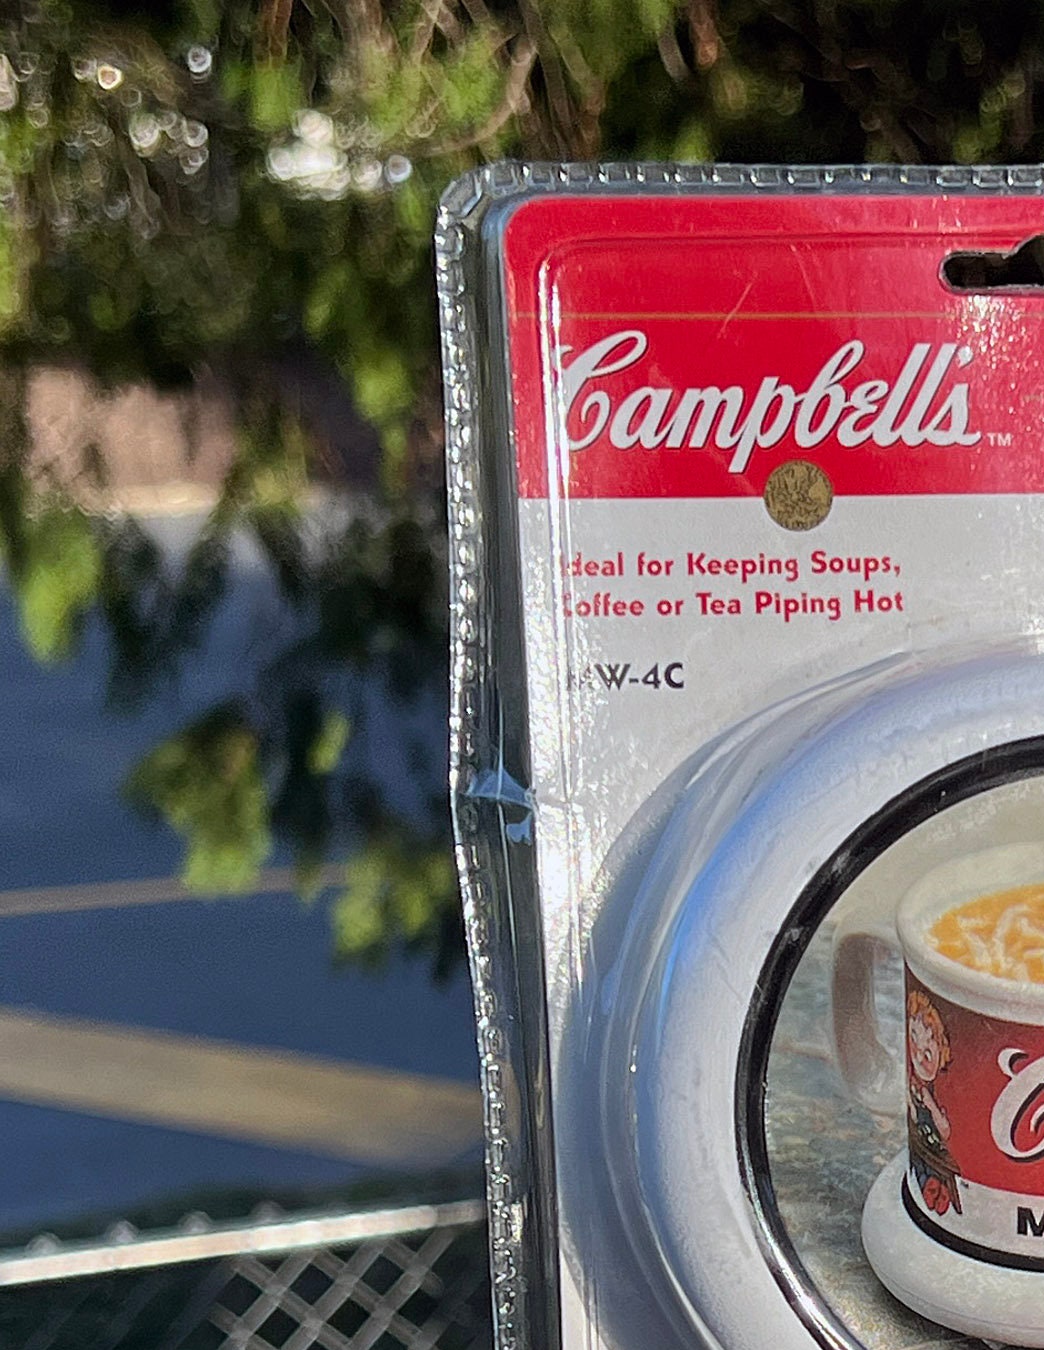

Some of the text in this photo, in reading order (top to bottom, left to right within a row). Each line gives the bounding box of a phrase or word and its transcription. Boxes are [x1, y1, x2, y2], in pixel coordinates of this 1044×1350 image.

[554, 329, 982, 474] Campbell's
[637, 551, 675, 577] for
[687, 551, 799, 582] Keeping
[811, 549, 901, 579] Soups,
[657, 599, 684, 616] or
[695, 591, 742, 616] Tea
[754, 590, 841, 622] Piping
[853, 588, 904, 613] Hot
